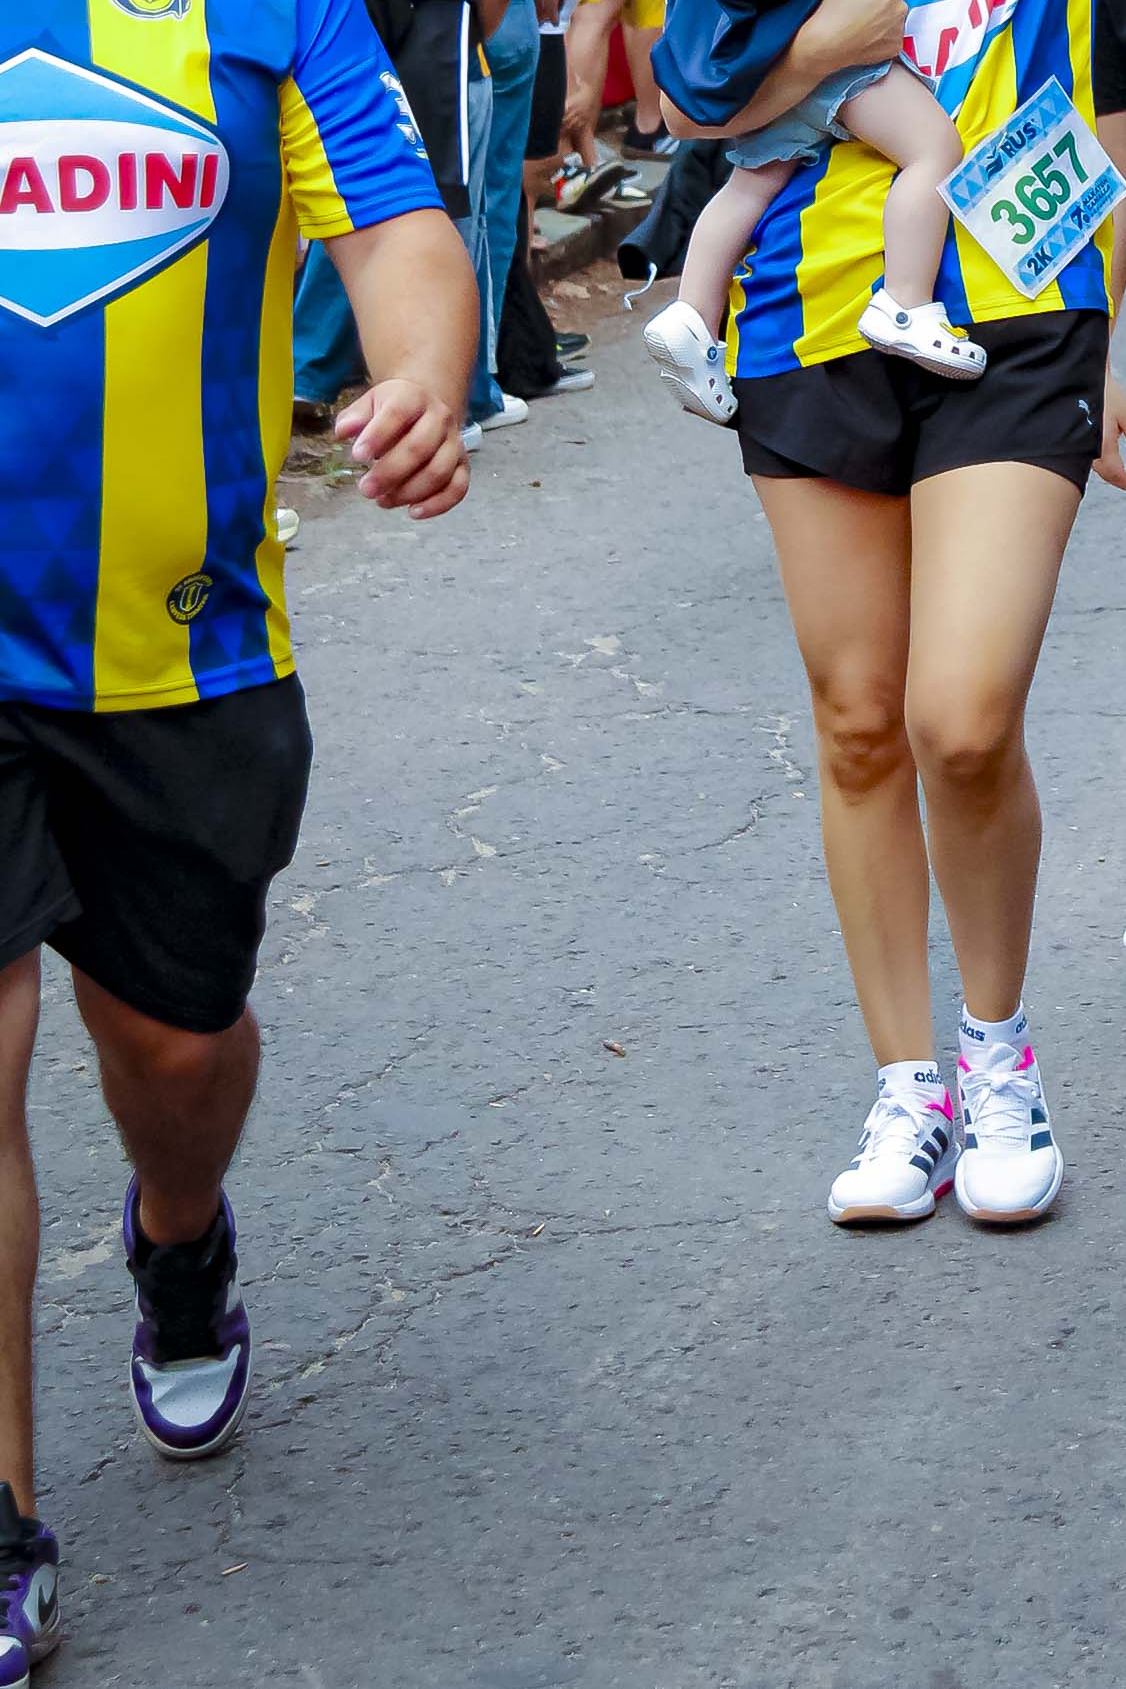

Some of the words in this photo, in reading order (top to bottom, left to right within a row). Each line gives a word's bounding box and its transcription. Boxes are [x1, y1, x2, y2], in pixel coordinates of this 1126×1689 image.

[1000, 121, 1038, 159] RUS
[991, 130, 1089, 245] 3657
[1027, 245, 1051, 276] 2K
